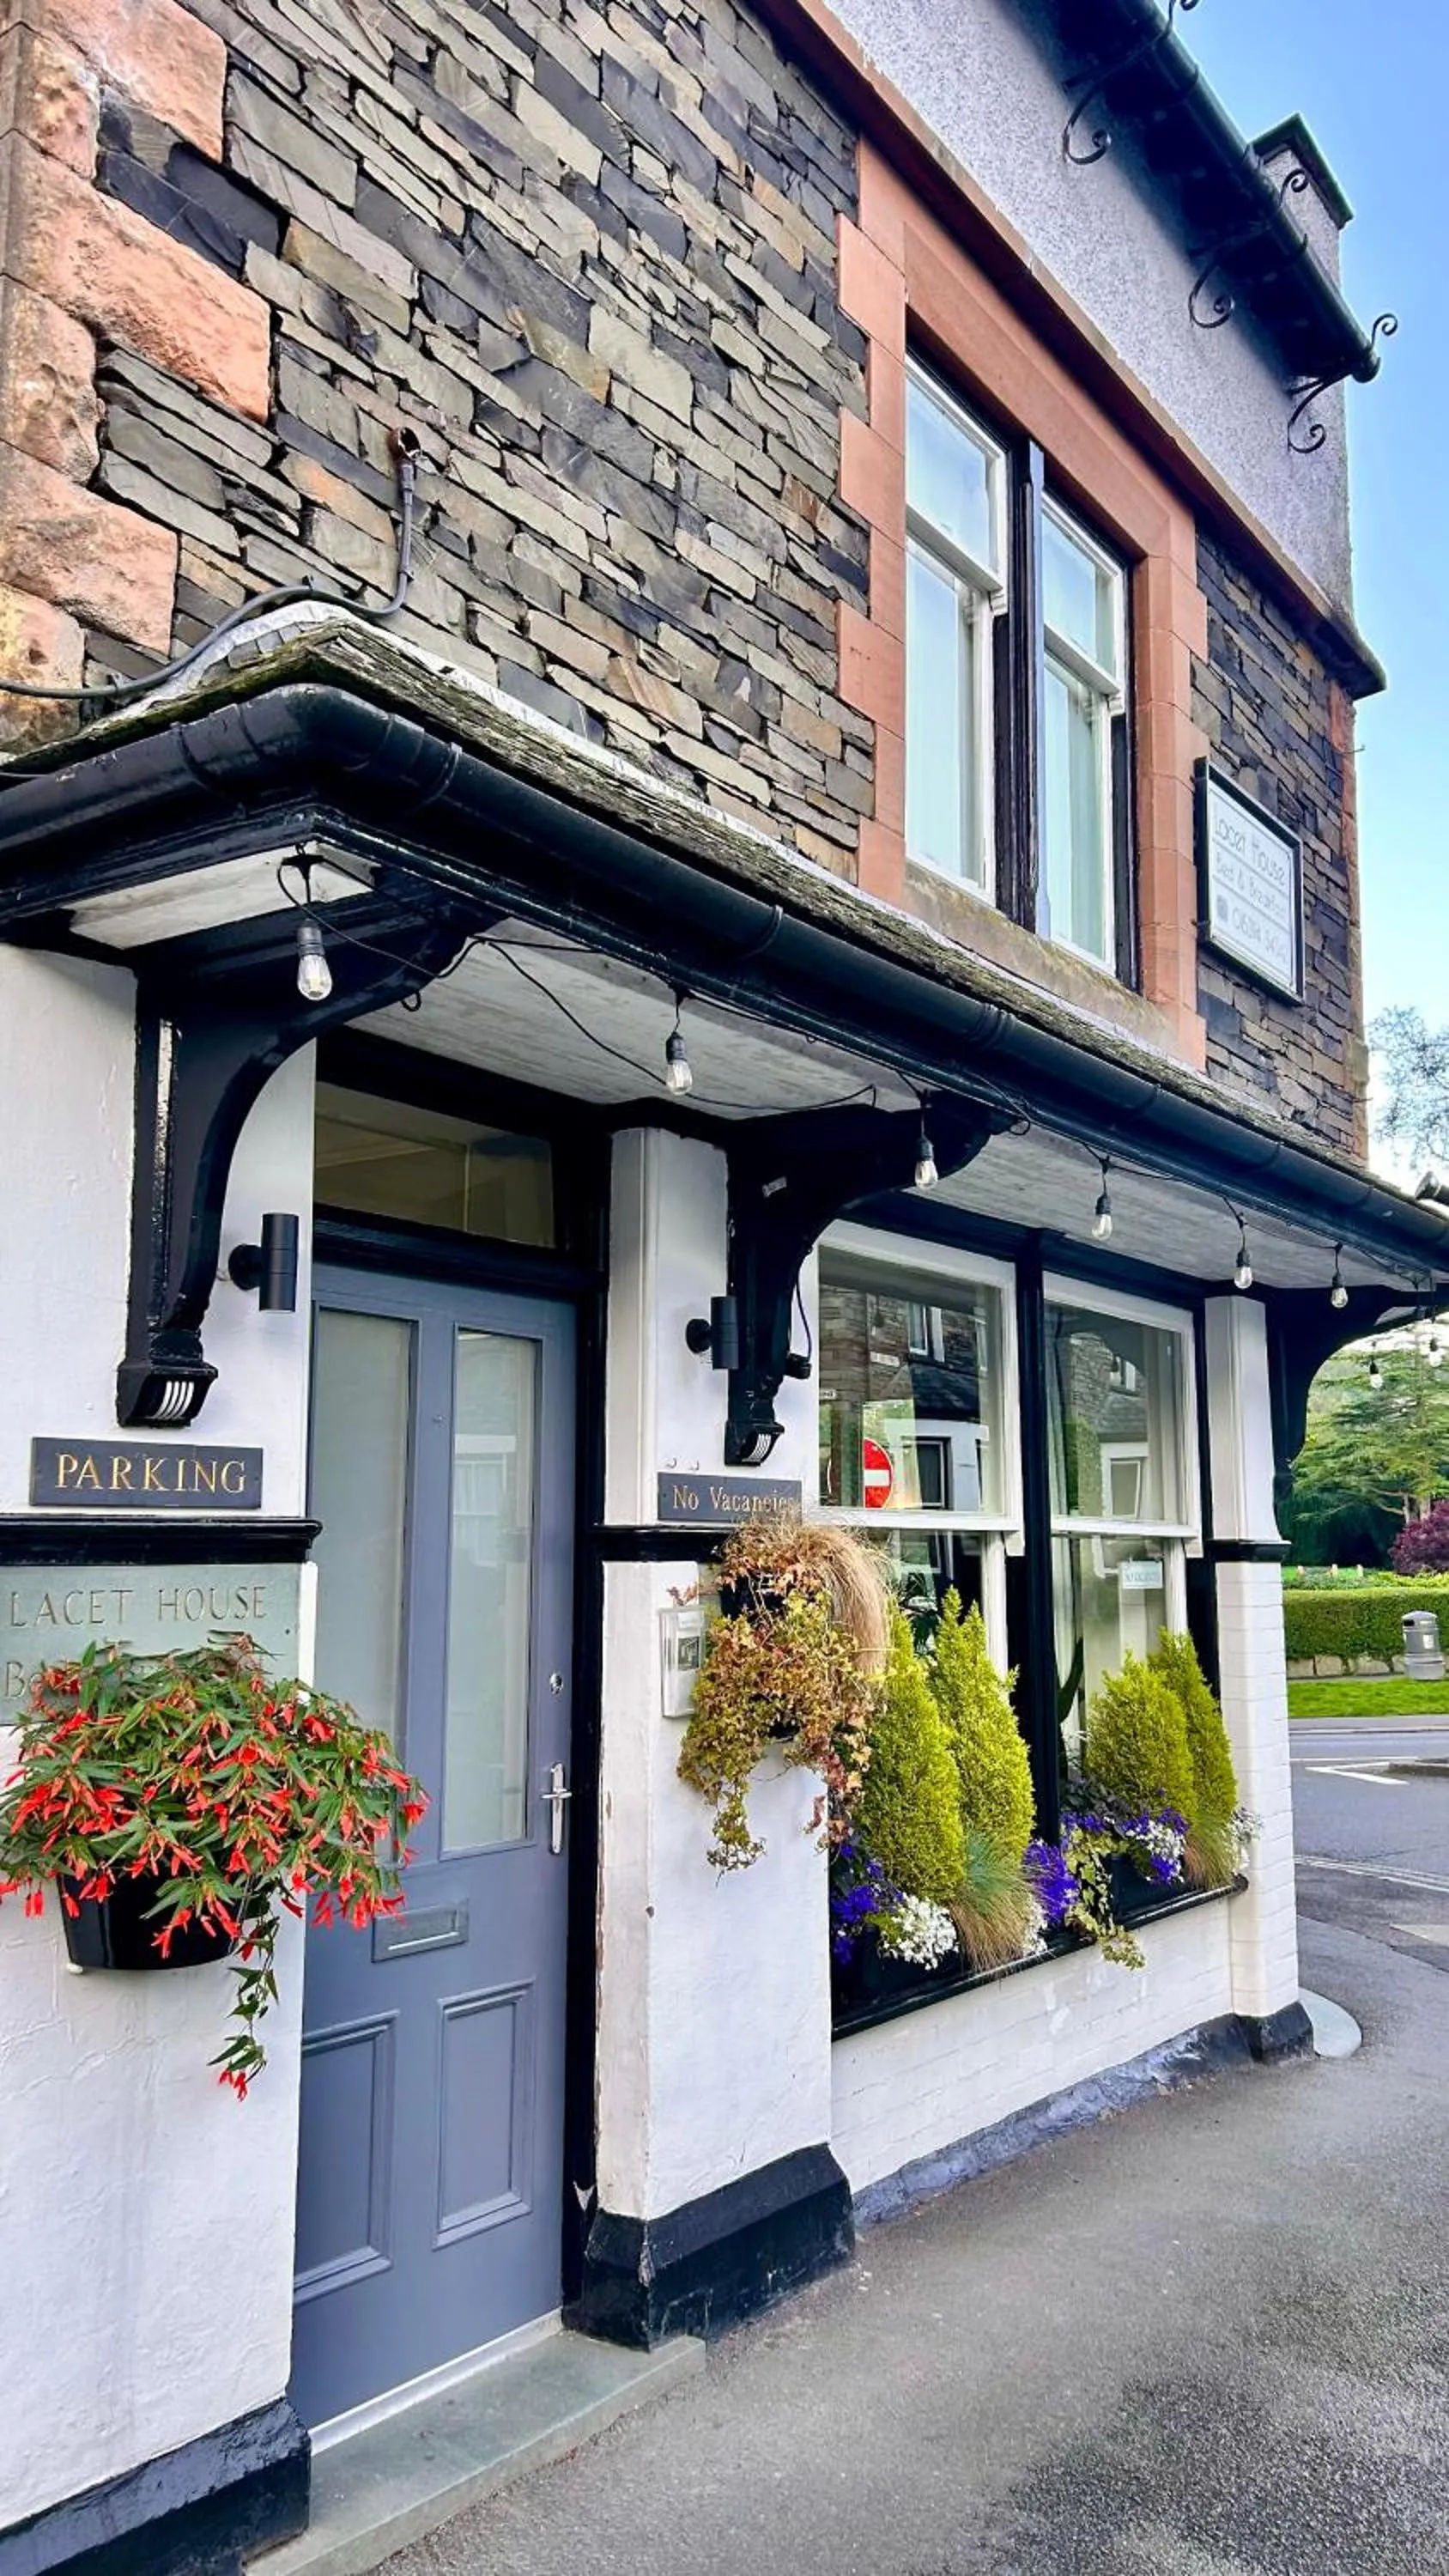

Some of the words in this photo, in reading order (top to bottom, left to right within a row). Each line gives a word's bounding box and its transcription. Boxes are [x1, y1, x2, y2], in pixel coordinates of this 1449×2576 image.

[55, 1453, 246, 1493] PARKING
[672, 1485, 700, 1510] No
[9, 1589, 133, 1627] LACET
[157, 1586, 267, 1622] HOUSE
